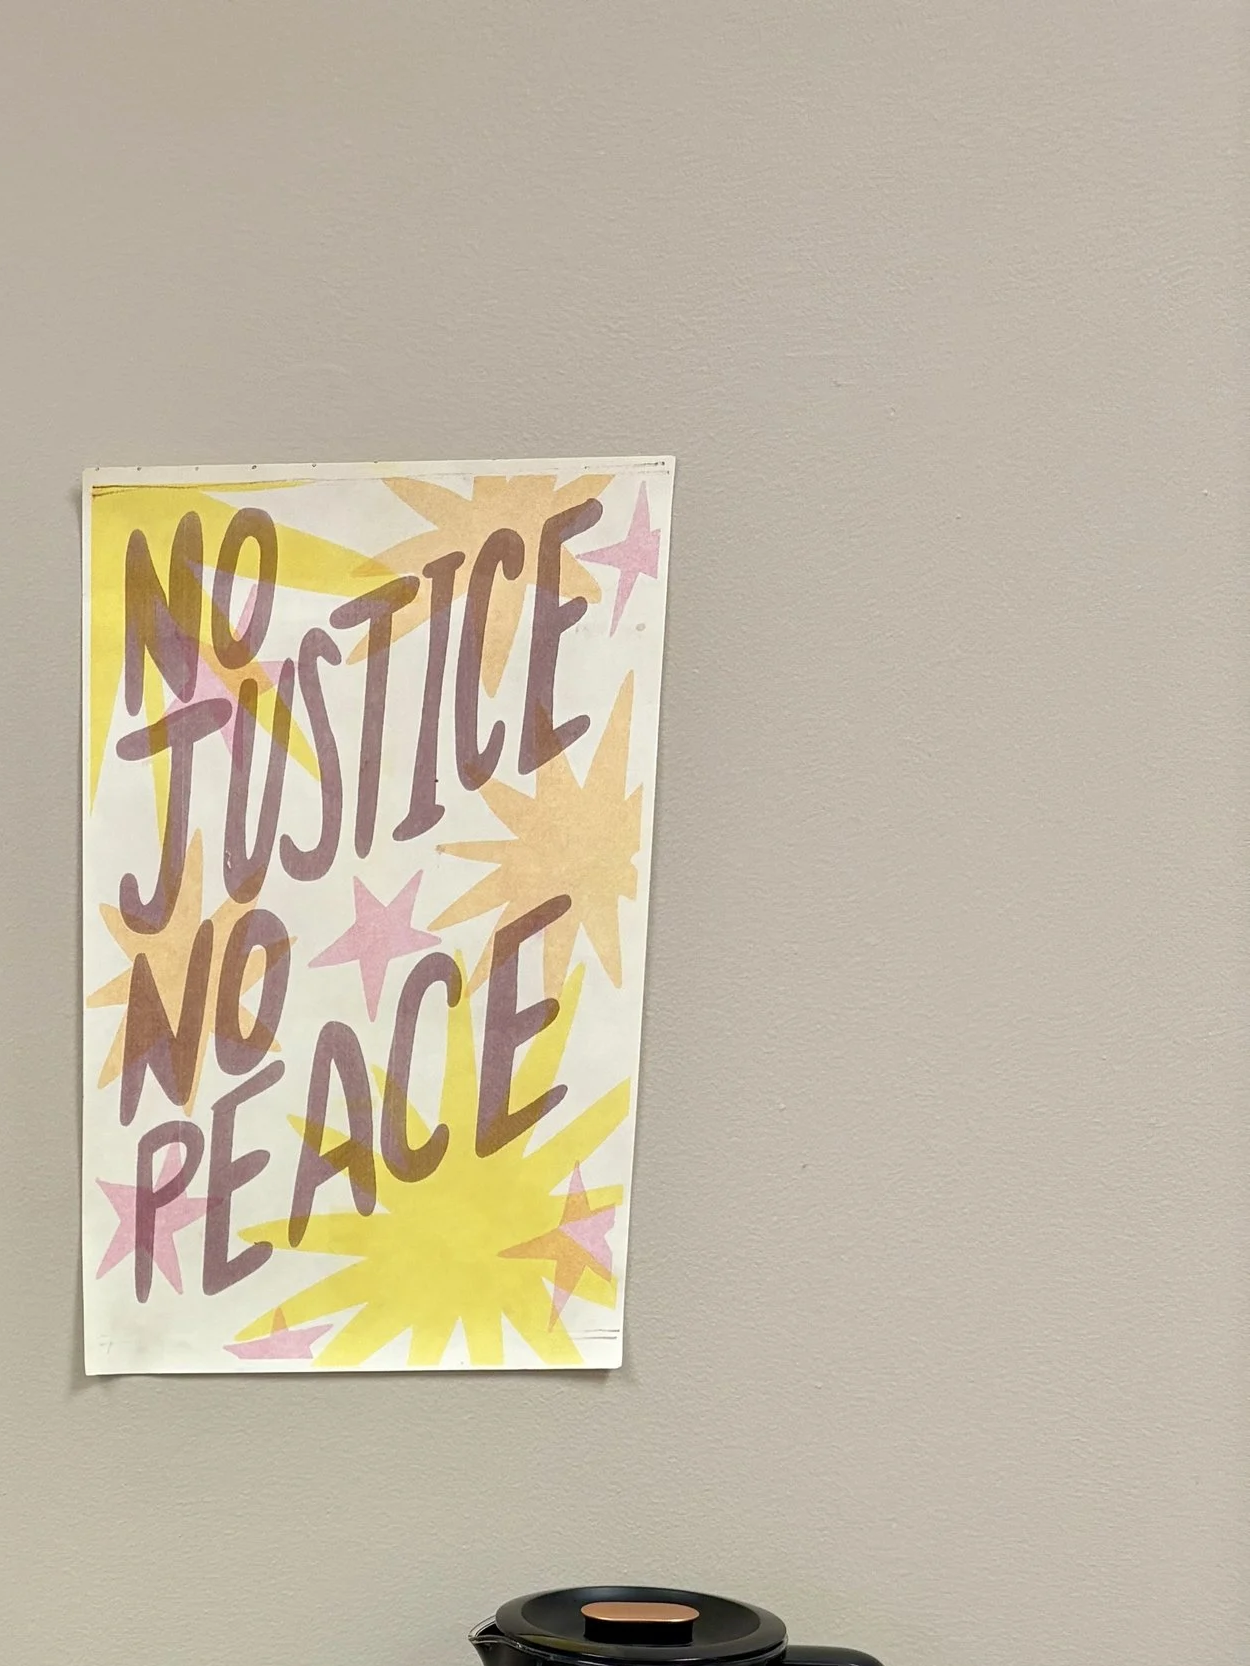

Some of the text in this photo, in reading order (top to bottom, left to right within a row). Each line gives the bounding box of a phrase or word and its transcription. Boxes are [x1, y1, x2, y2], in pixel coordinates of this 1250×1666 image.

[117, 498, 603, 934] JUSTICE
[124, 507, 277, 715] NO
[120, 908, 290, 1125] NO
[136, 894, 573, 1303] PEACE
